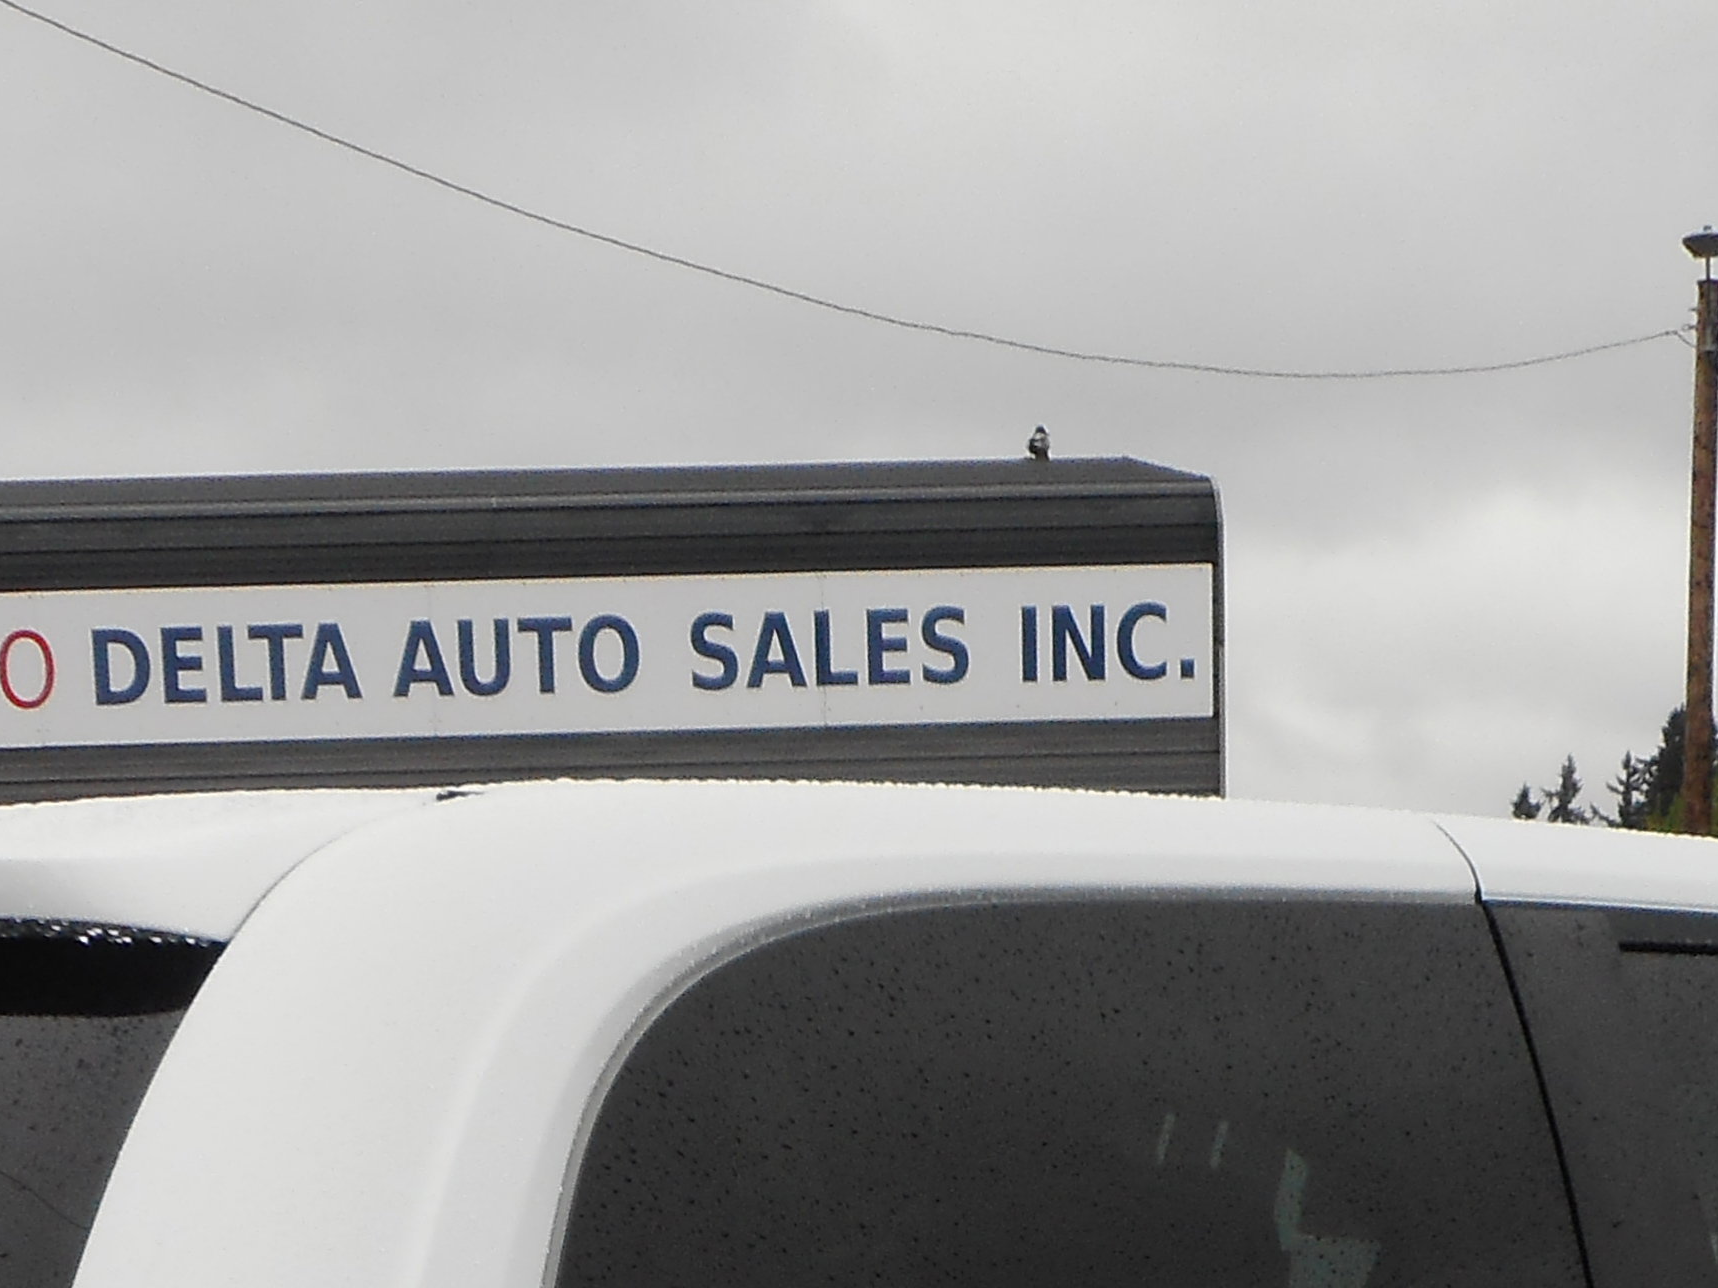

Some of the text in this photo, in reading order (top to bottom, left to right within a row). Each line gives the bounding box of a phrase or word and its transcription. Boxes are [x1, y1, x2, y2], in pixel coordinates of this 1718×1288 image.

[90, 621, 364, 706] DELTA
[392, 613, 642, 698] AUTO
[689, 604, 971, 692] SALES
[1019, 601, 1196, 683] INC.
